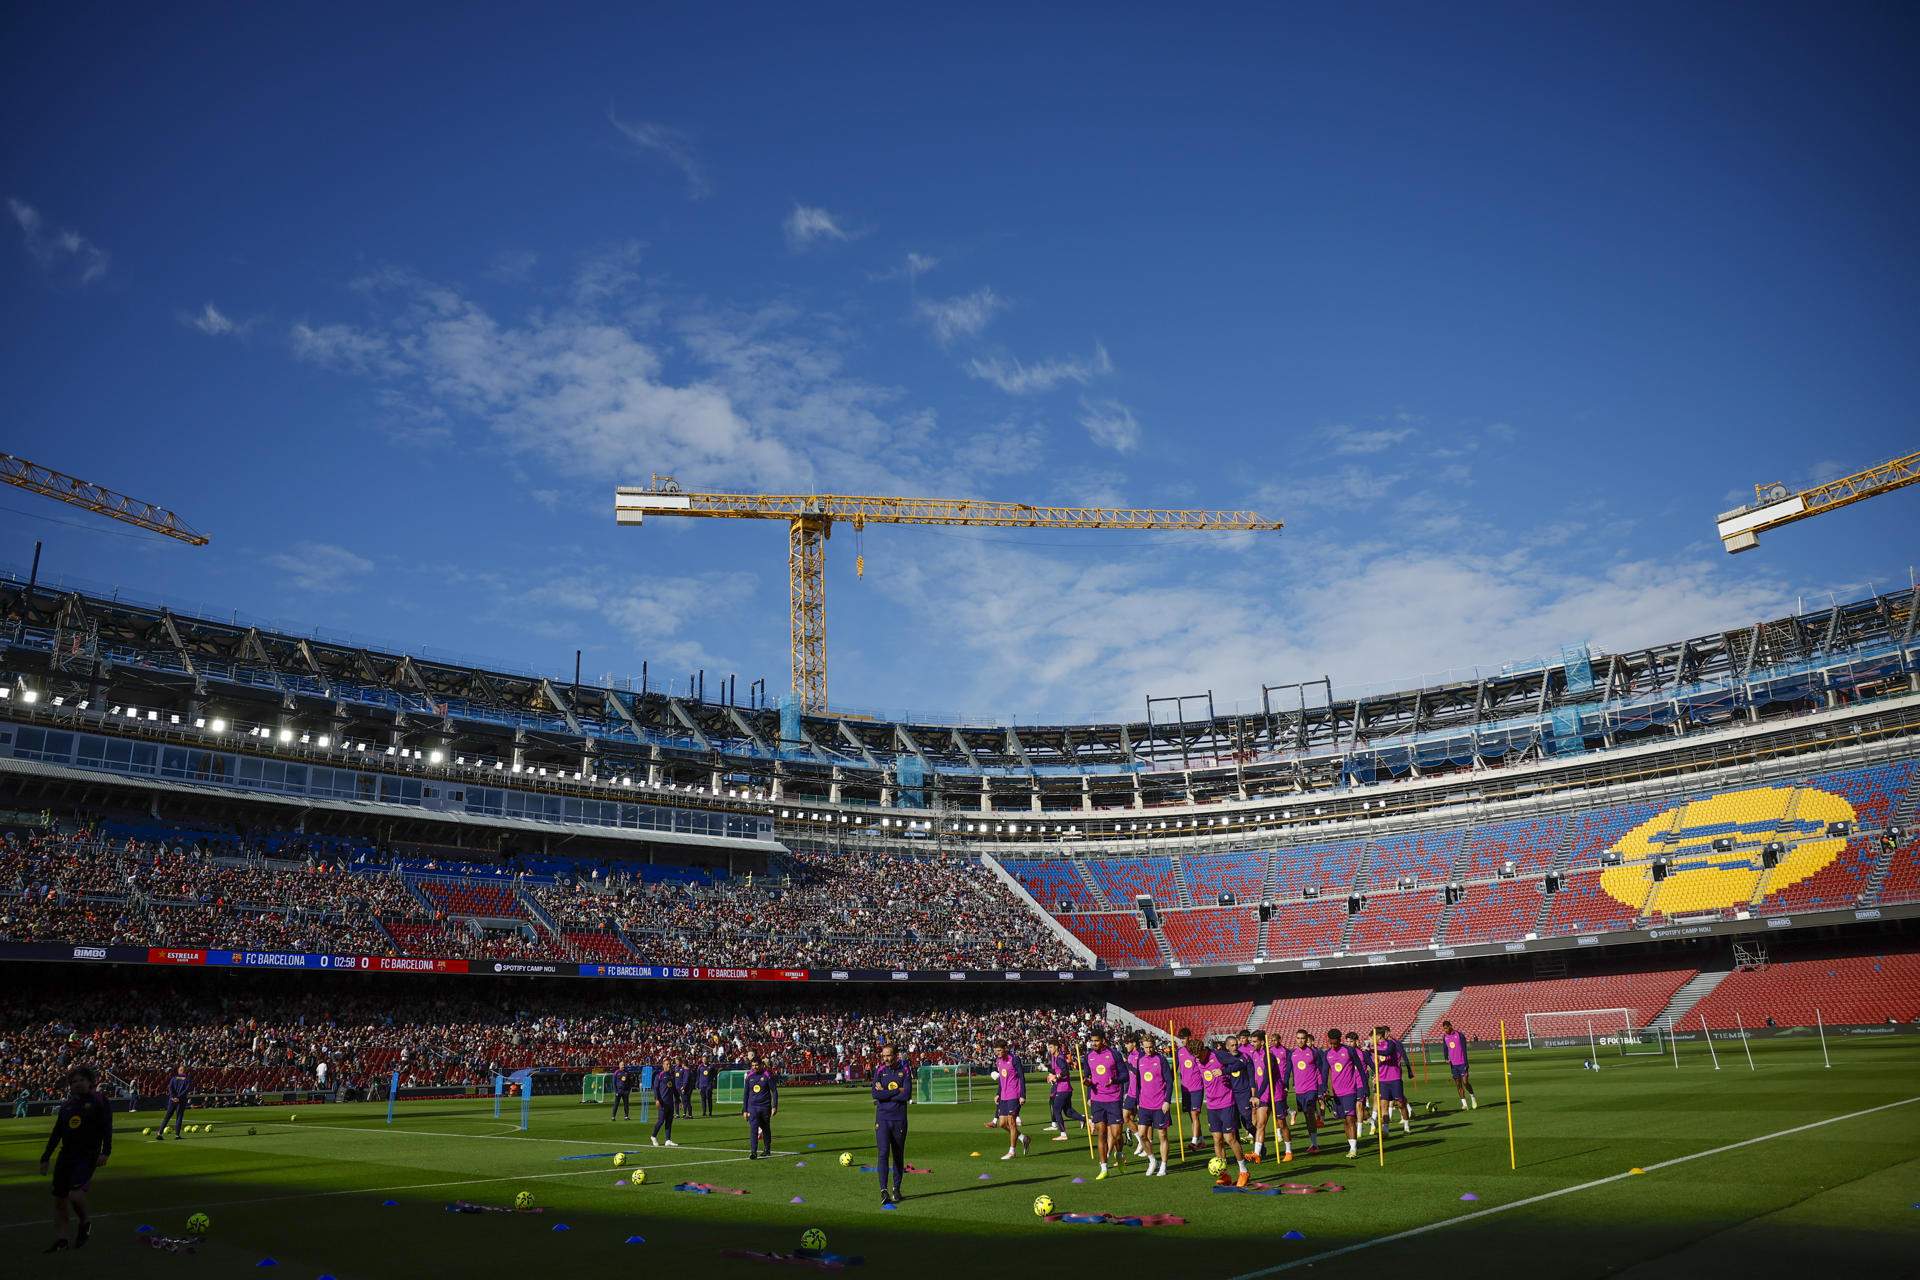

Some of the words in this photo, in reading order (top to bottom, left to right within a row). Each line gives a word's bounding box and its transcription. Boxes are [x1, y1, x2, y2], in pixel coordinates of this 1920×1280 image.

[73, 947, 107, 959] BIMBO
[167, 952, 199, 960] ESTRELLA
[246, 953, 256, 964] FC
[258, 953, 305, 966] BARCELONA
[320, 955, 329, 967] 0
[334, 956, 356, 968] 02:58
[361, 957, 369, 968] 0
[380, 958, 390, 969] FC
[391, 959, 434, 970] BARCELONA
[502, 964, 526, 972] SPOTIFY
[608, 966, 616, 975] FC
[616, 966, 652, 976] BARCELONA
[662, 967, 669, 977] 0
[693, 968, 699, 977] 0
[707, 968, 715, 977] FC
[715, 968, 748, 978] BARCELONA
